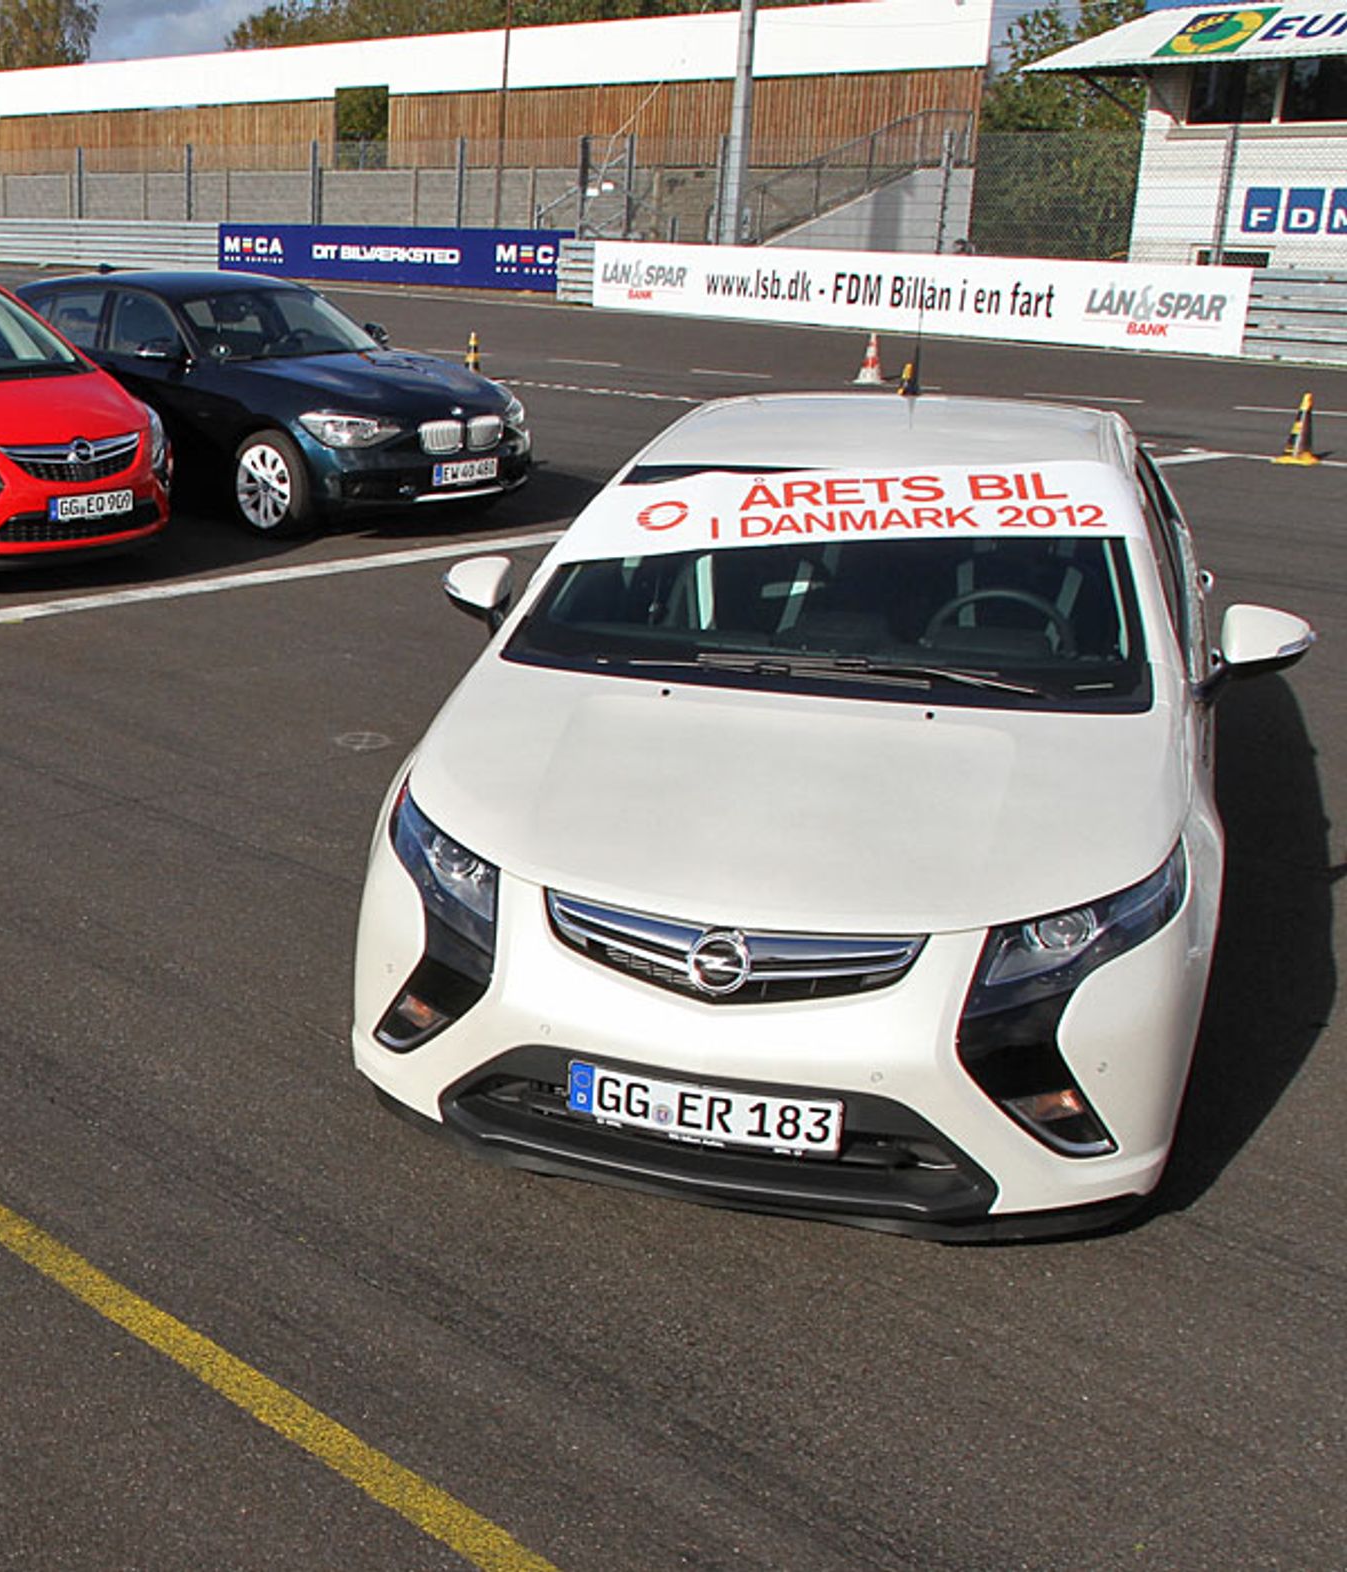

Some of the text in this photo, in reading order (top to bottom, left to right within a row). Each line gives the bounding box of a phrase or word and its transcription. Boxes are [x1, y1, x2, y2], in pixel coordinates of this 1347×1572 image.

[224, 236, 283, 255] MECA
[312, 244, 338, 259] DIT
[496, 244, 559, 264] MEC
[706, 269, 811, 302] www.lsb.dk
[832, 272, 882, 306] FDM
[959, 278, 967, 312] i
[974, 288, 1000, 315] en
[1010, 281, 1054, 318] fart
[1126, 321, 1168, 336] BANK
[739, 472, 1068, 511] ÅRETS BIL
[60, 499, 80, 515] GG
[711, 505, 1107, 539] I DANMARK 2012
[597, 1076, 832, 1143] GG ER 183
